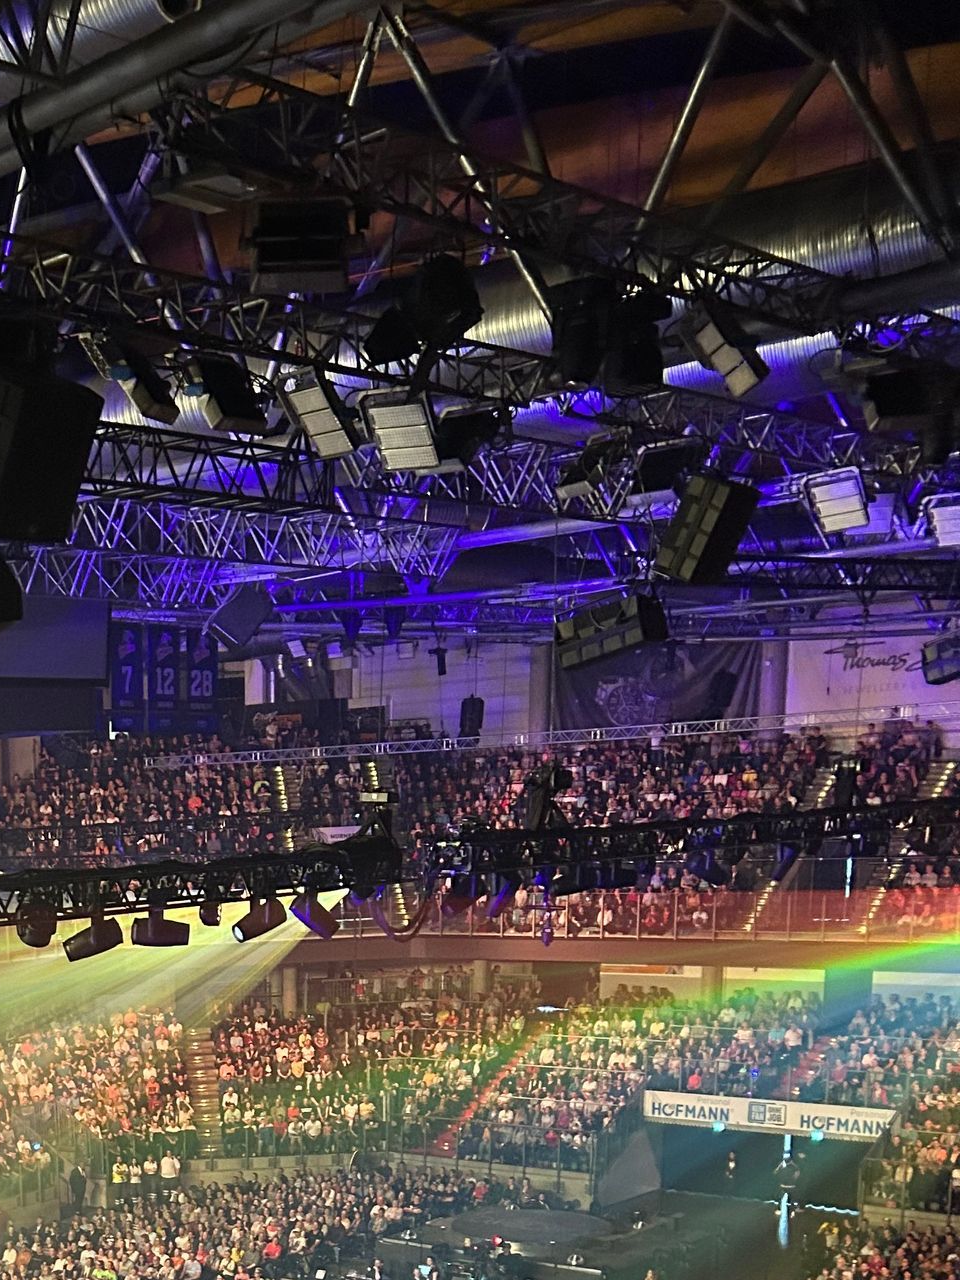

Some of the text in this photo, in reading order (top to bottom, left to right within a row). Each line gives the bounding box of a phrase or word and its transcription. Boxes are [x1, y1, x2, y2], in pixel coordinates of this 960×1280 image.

[121, 665, 133, 694] 7
[156, 666, 175, 695] 12
[191, 669, 213, 697] 28
[652, 1102, 730, 1121] HOFMANN
[800, 1114, 887, 1135] HOFMANN
